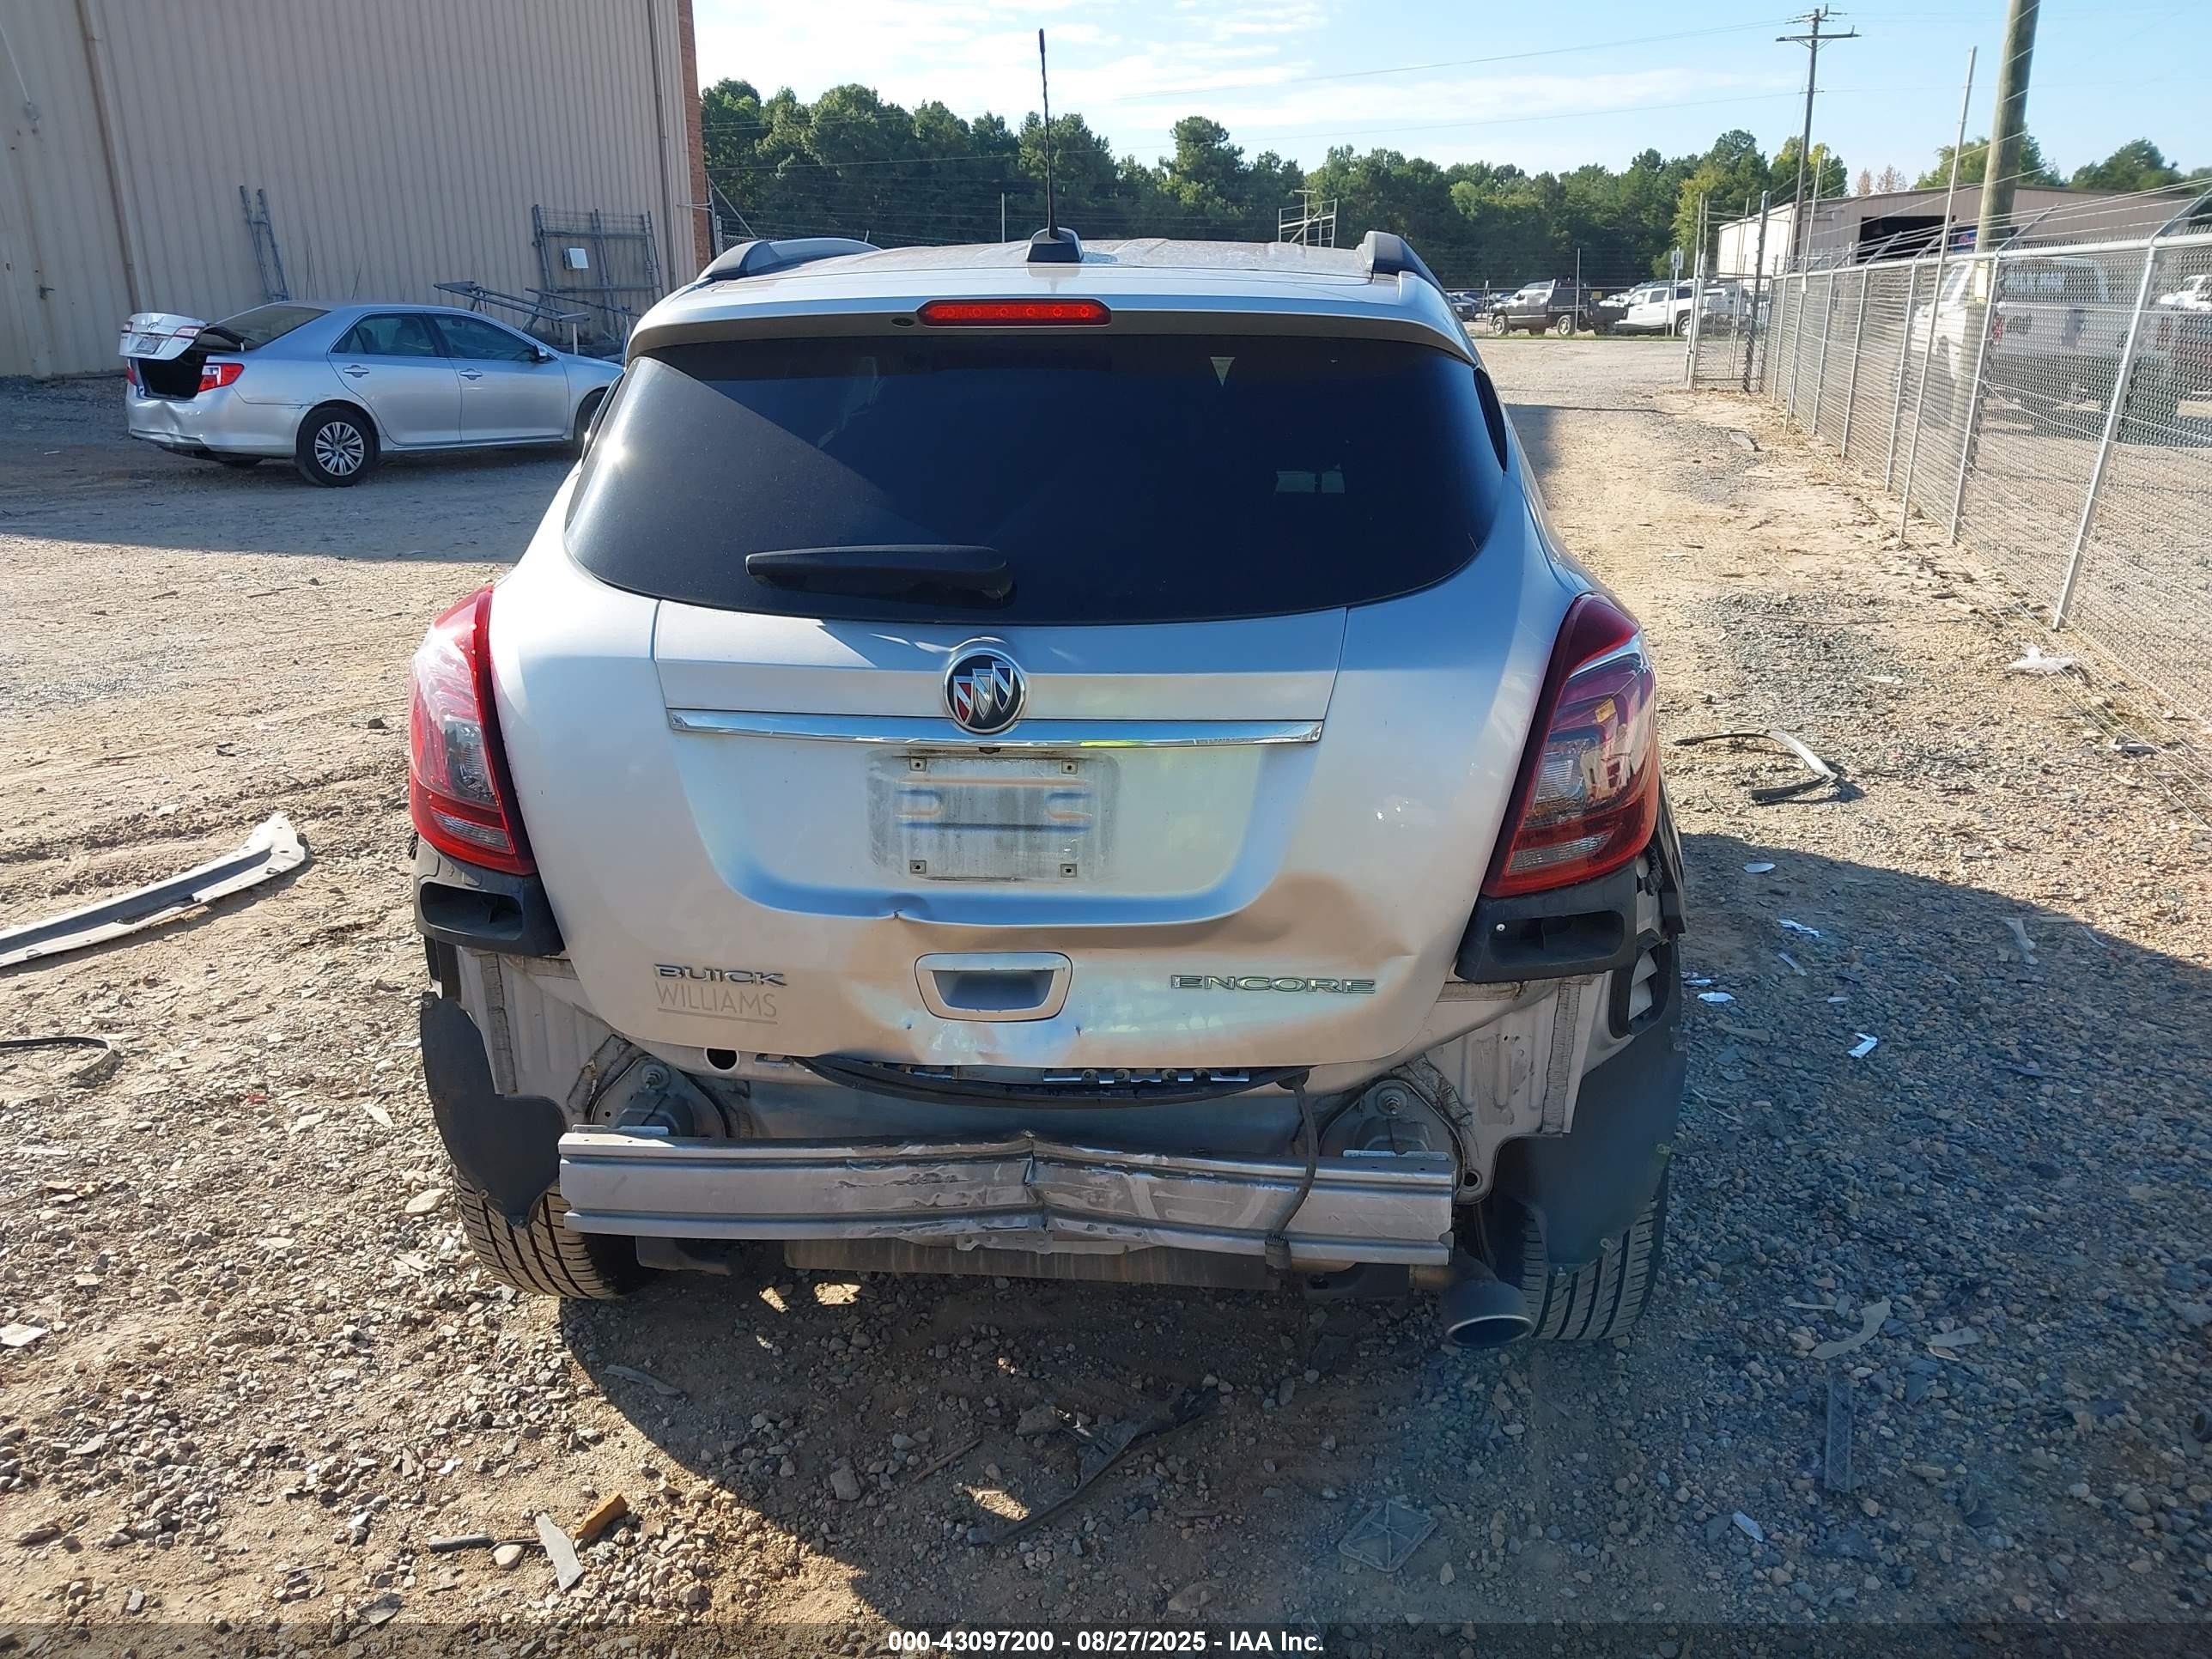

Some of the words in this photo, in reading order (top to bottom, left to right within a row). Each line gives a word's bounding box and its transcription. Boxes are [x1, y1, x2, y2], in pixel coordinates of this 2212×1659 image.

[654, 963, 787, 988] BUICK
[1170, 975, 1376, 994] ENCORE
[654, 981, 778, 1018] WILLIAMS
